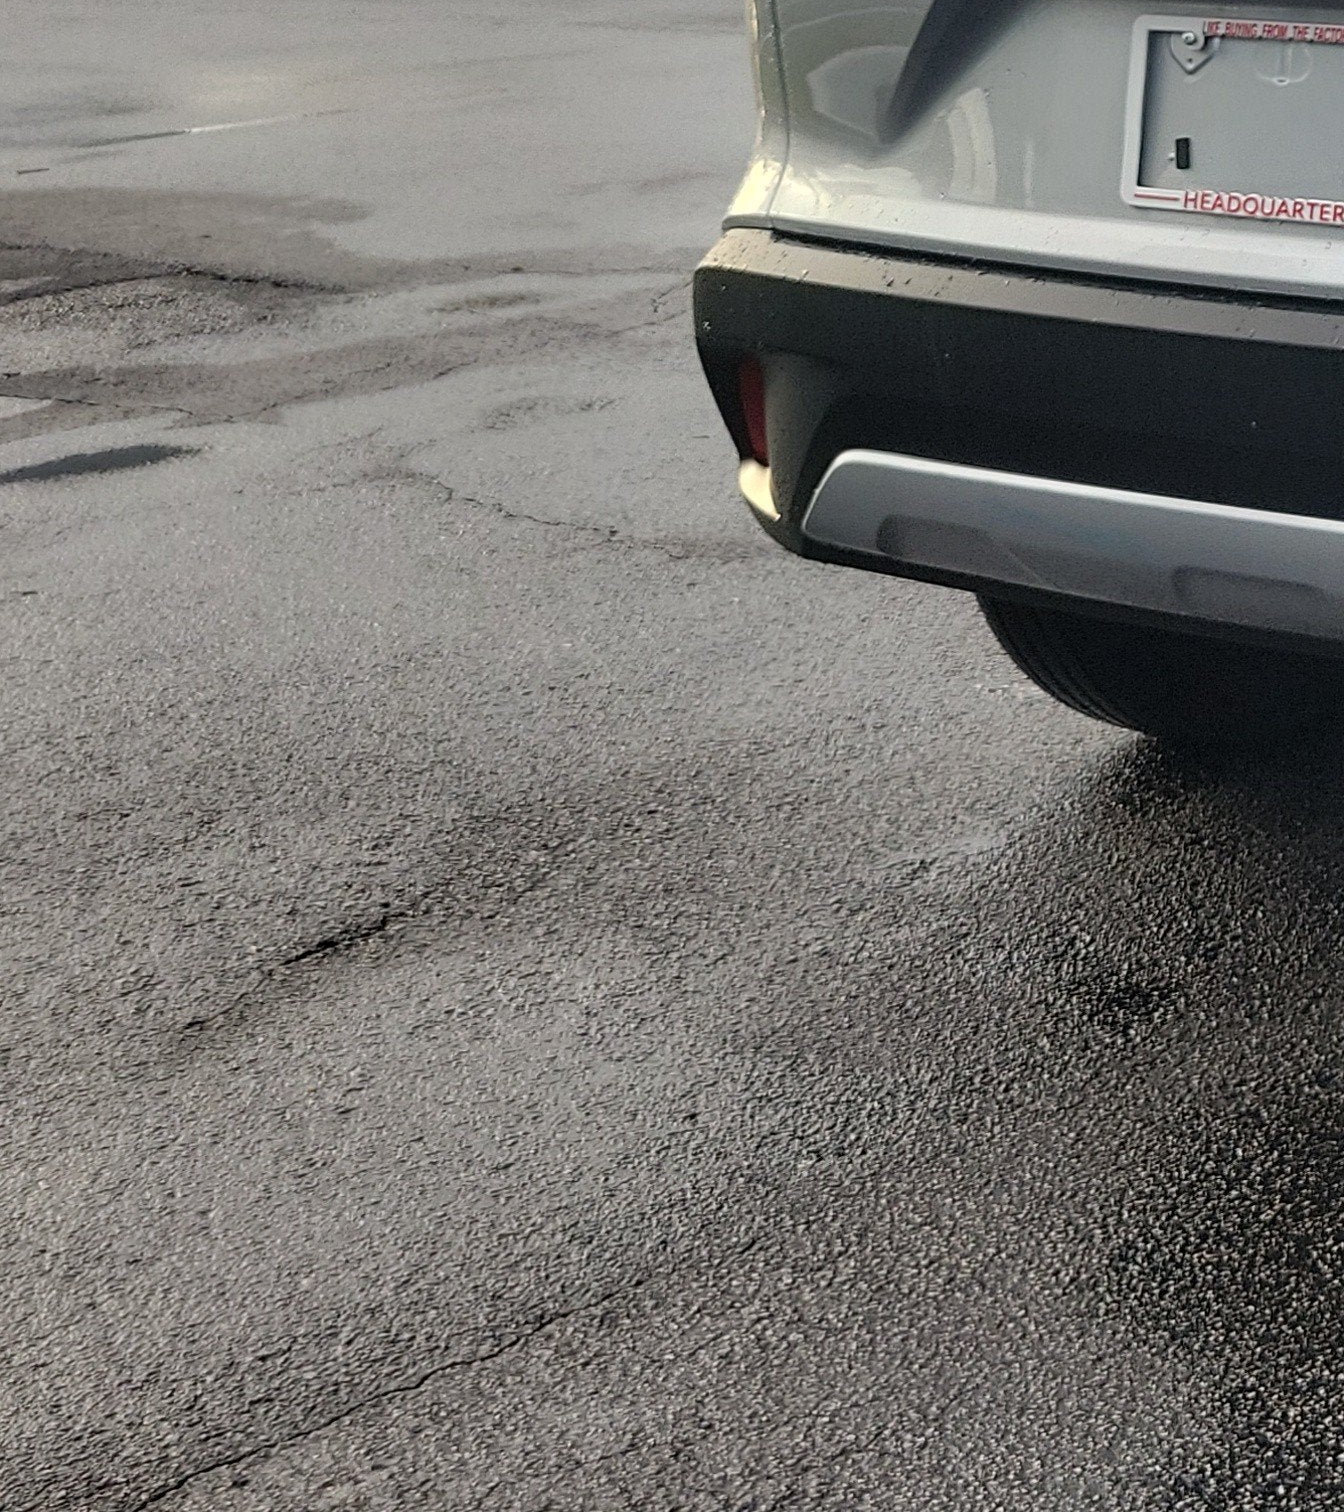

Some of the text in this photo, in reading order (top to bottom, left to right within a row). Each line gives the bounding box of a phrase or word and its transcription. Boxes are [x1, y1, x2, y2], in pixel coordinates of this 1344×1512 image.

[1225, 22, 1258, 38] BUYING
[1262, 23, 1289, 39] FROM
[1293, 25, 1310, 40] THE
